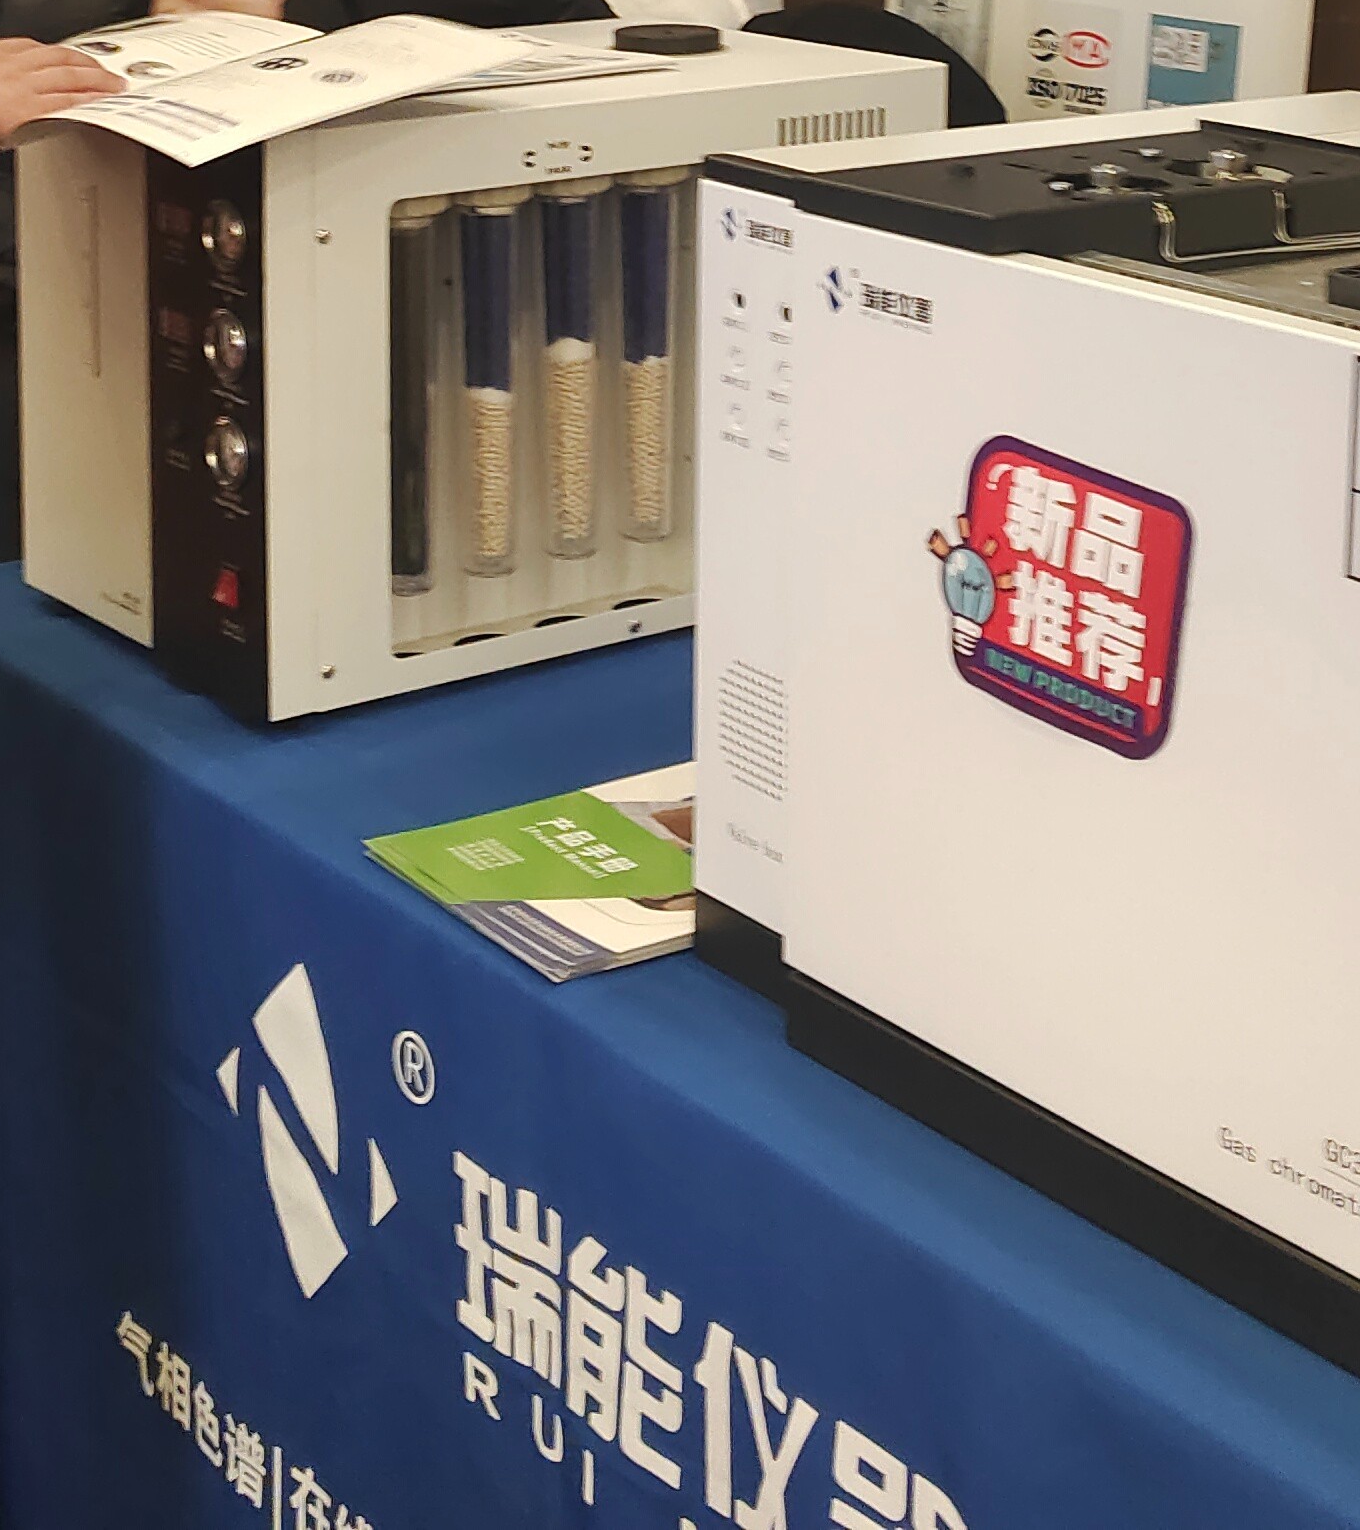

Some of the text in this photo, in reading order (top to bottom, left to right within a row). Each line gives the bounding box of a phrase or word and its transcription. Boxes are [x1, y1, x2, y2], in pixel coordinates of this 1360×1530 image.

[1002, 465, 1144, 599] 新品
[1007, 560, 1147, 691] 推荐
[985, 647, 1138, 730] NEW PRODUCT
[1218, 1126, 1257, 1163] Gas
